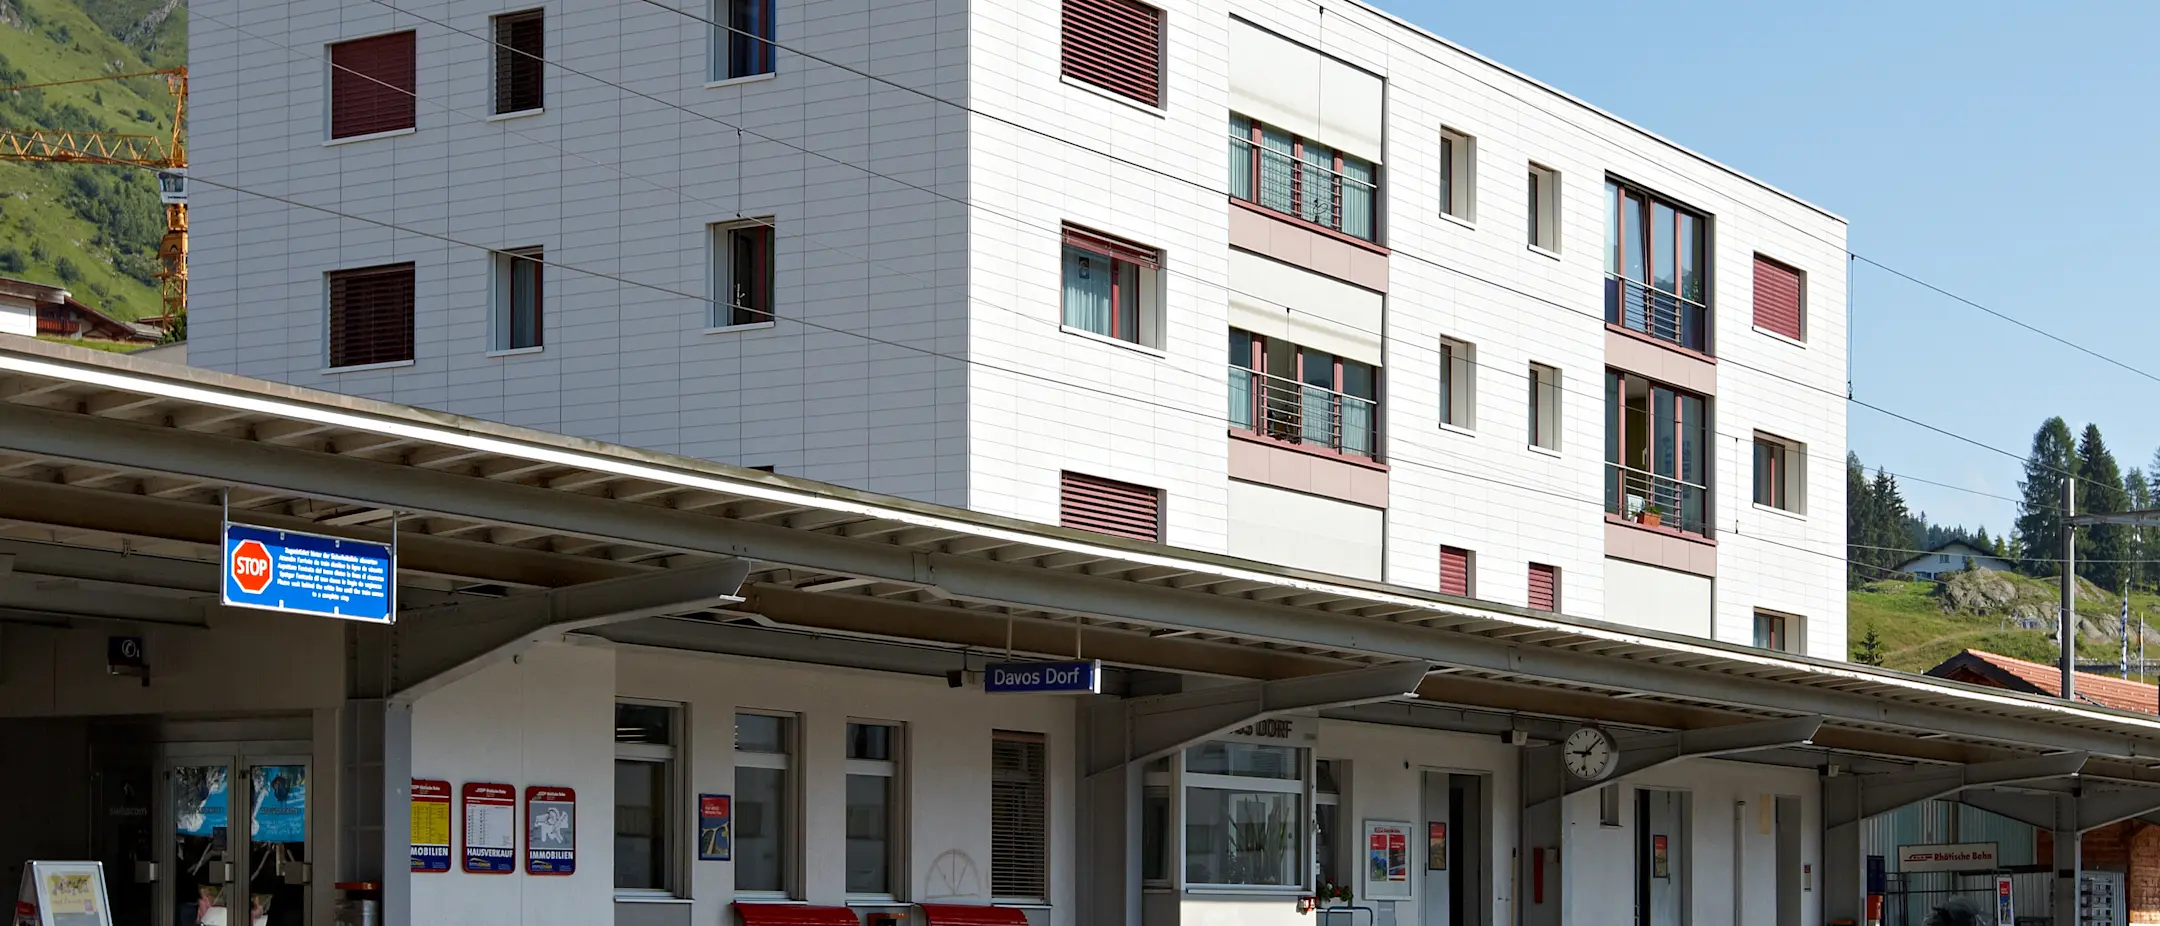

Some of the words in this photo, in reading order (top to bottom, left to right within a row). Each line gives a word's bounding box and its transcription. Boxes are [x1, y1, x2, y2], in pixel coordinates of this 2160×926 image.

[236, 556, 268, 576] STOP
[994, 668, 1040, 685] Davos
[1046, 667, 1080, 684] Dorf
[1256, 718, 1292, 738] DORF
[410, 846, 448, 856] MOBILIEN
[466, 848, 514, 858] HAUSVERKAUF
[529, 850, 574, 860] IMMOBILIEN
[1934, 852, 1970, 861] Rhätische
[1972, 851, 1992, 860] Bahn
